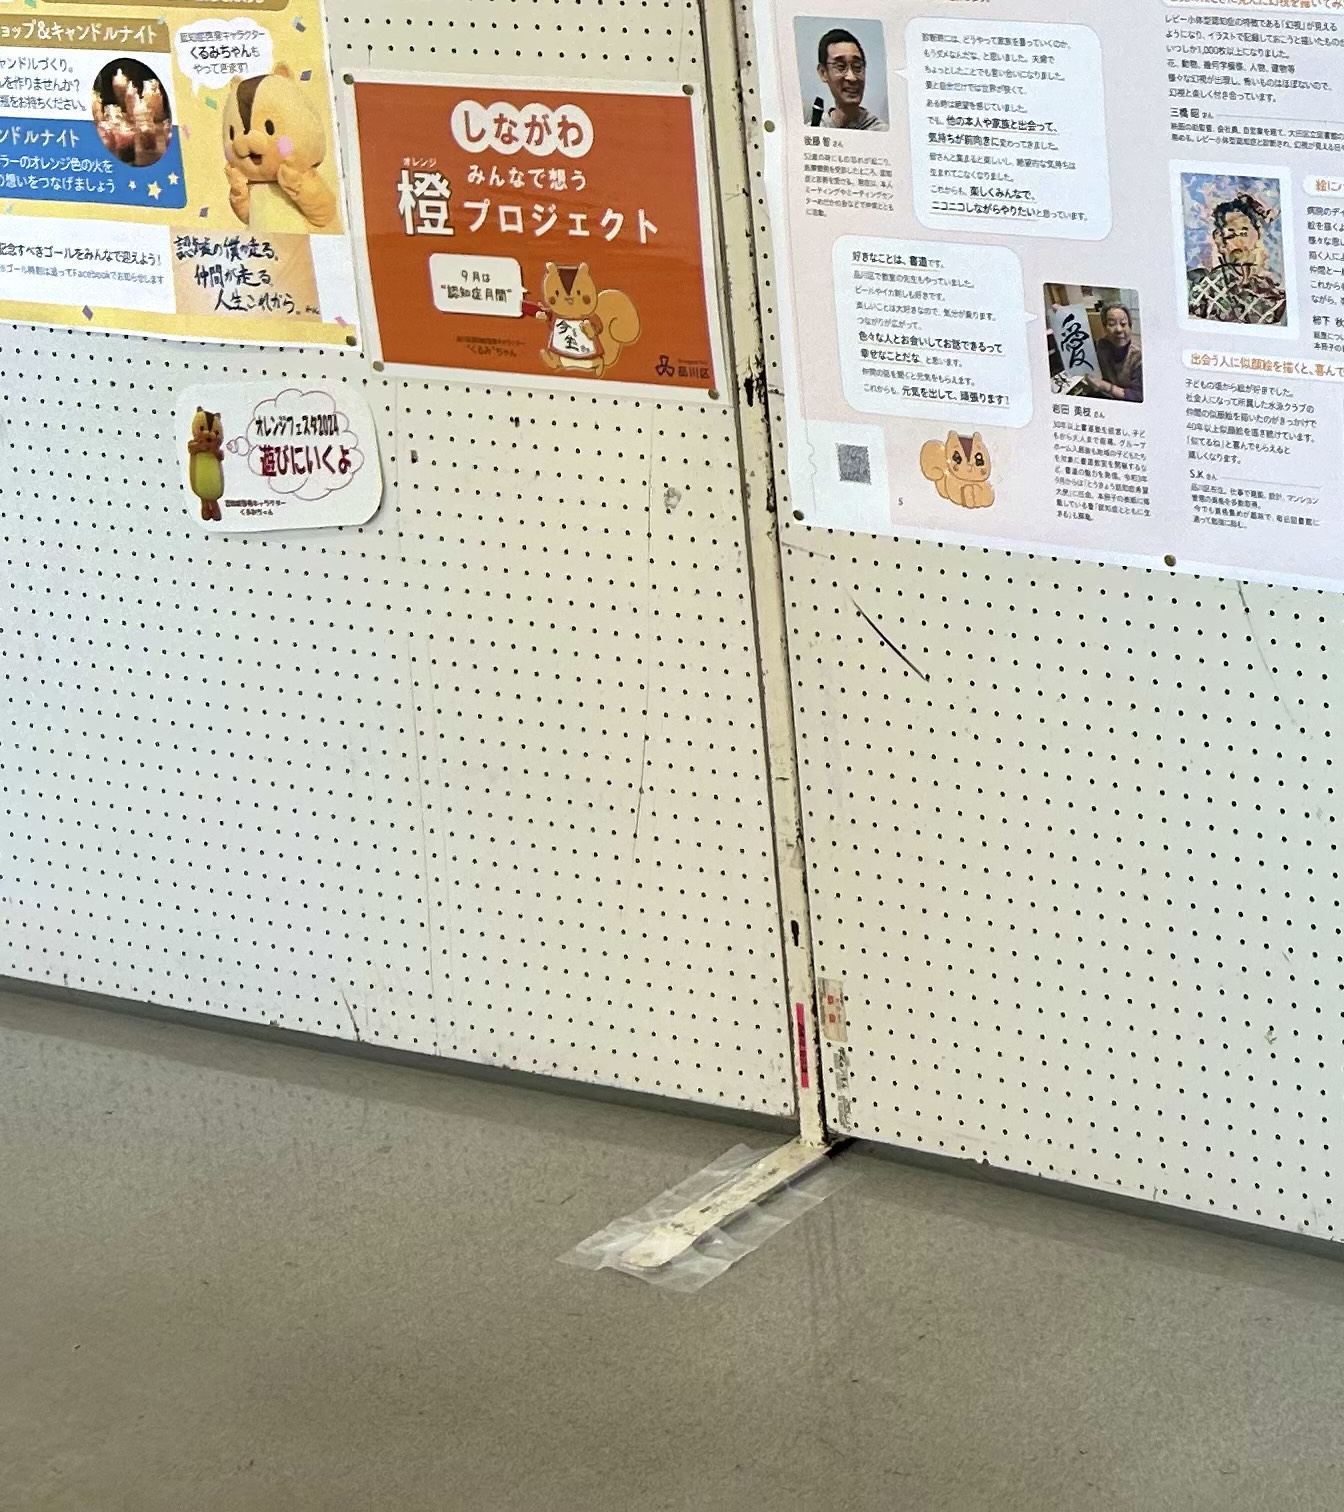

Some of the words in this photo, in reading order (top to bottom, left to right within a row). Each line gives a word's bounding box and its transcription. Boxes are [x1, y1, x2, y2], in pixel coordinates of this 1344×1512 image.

[189, 44, 260, 59] くるみちゃんも
[463, 110, 585, 147] しながわ
[402, 157, 437, 168] オレンジ
[467, 164, 587, 191] みんなで想う
[397, 169, 454, 235] 橙
[463, 198, 658, 245] プロジェクト
[460, 269, 491, 283] 9月は
[1059, 314, 1094, 371] 愛
[255, 414, 339, 436] オレンジフェスタ2024
[259, 444, 352, 477] 遊びにいくよ
